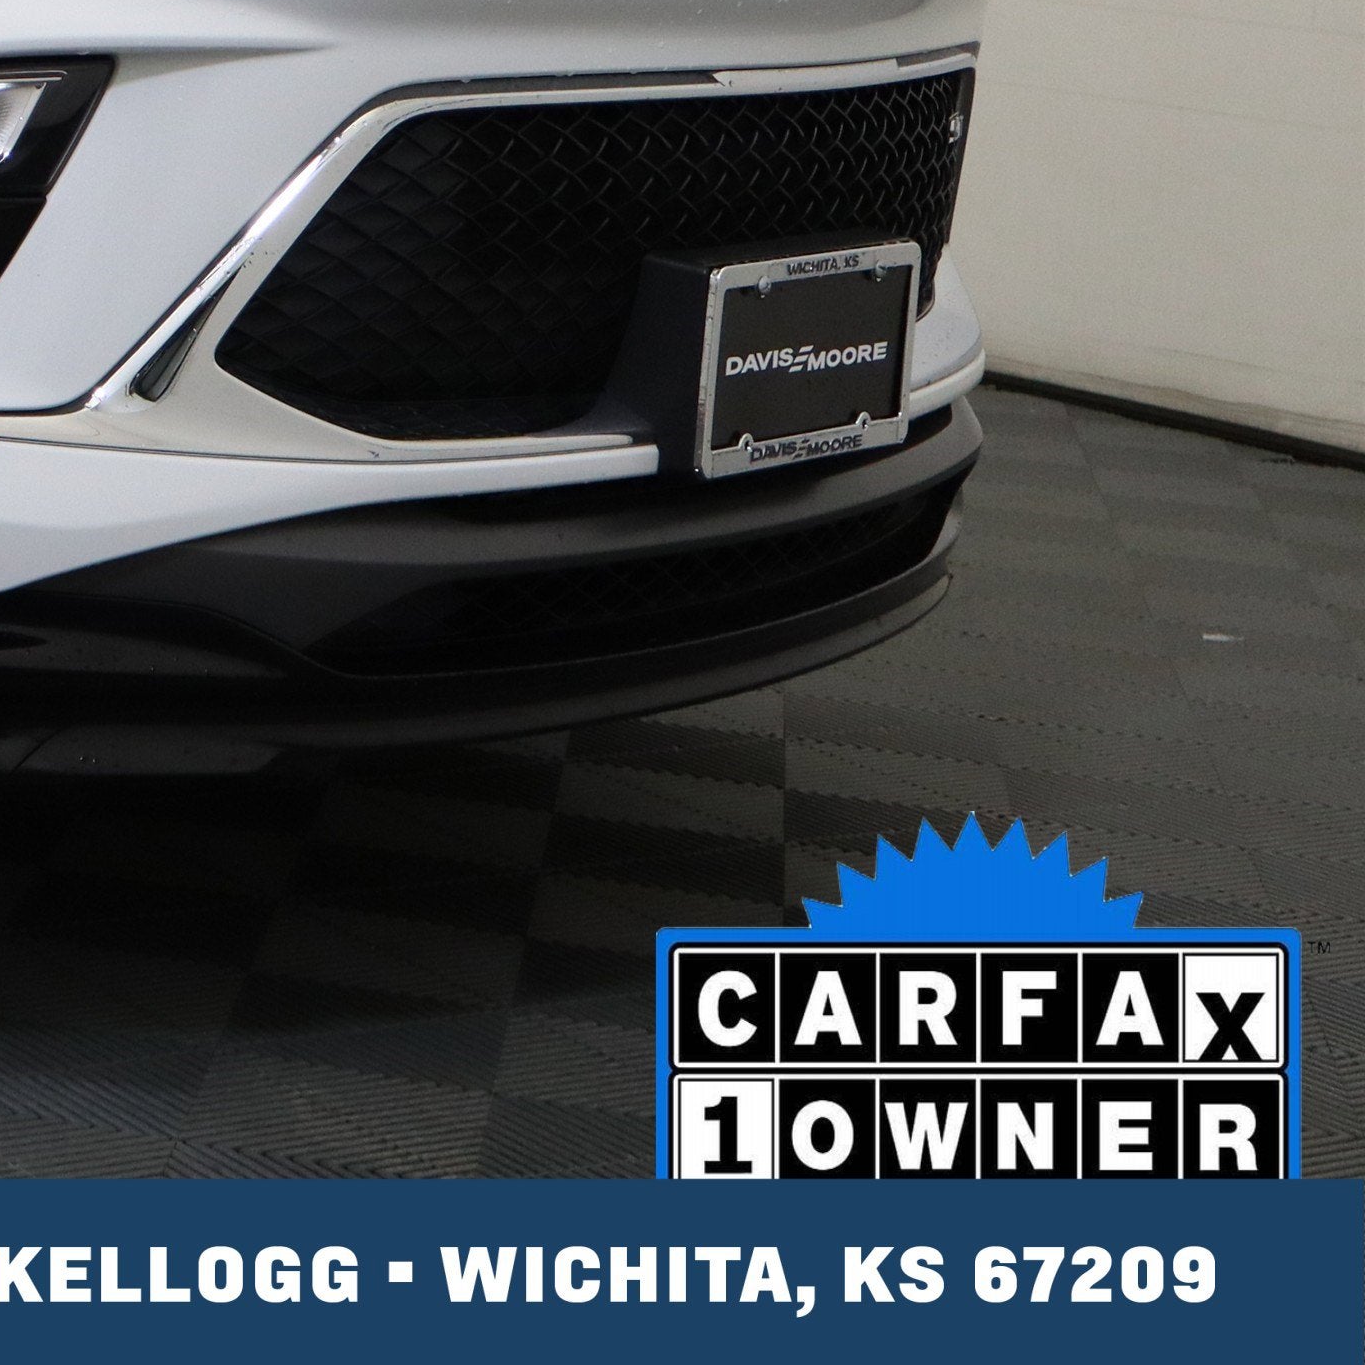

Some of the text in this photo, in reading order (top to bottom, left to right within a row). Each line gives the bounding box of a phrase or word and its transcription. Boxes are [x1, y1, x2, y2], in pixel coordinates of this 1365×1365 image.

[844, 255, 860, 269] KS
[725, 341, 889, 377] DAVIS MOORE
[749, 434, 864, 463] DAVIS MOORE
